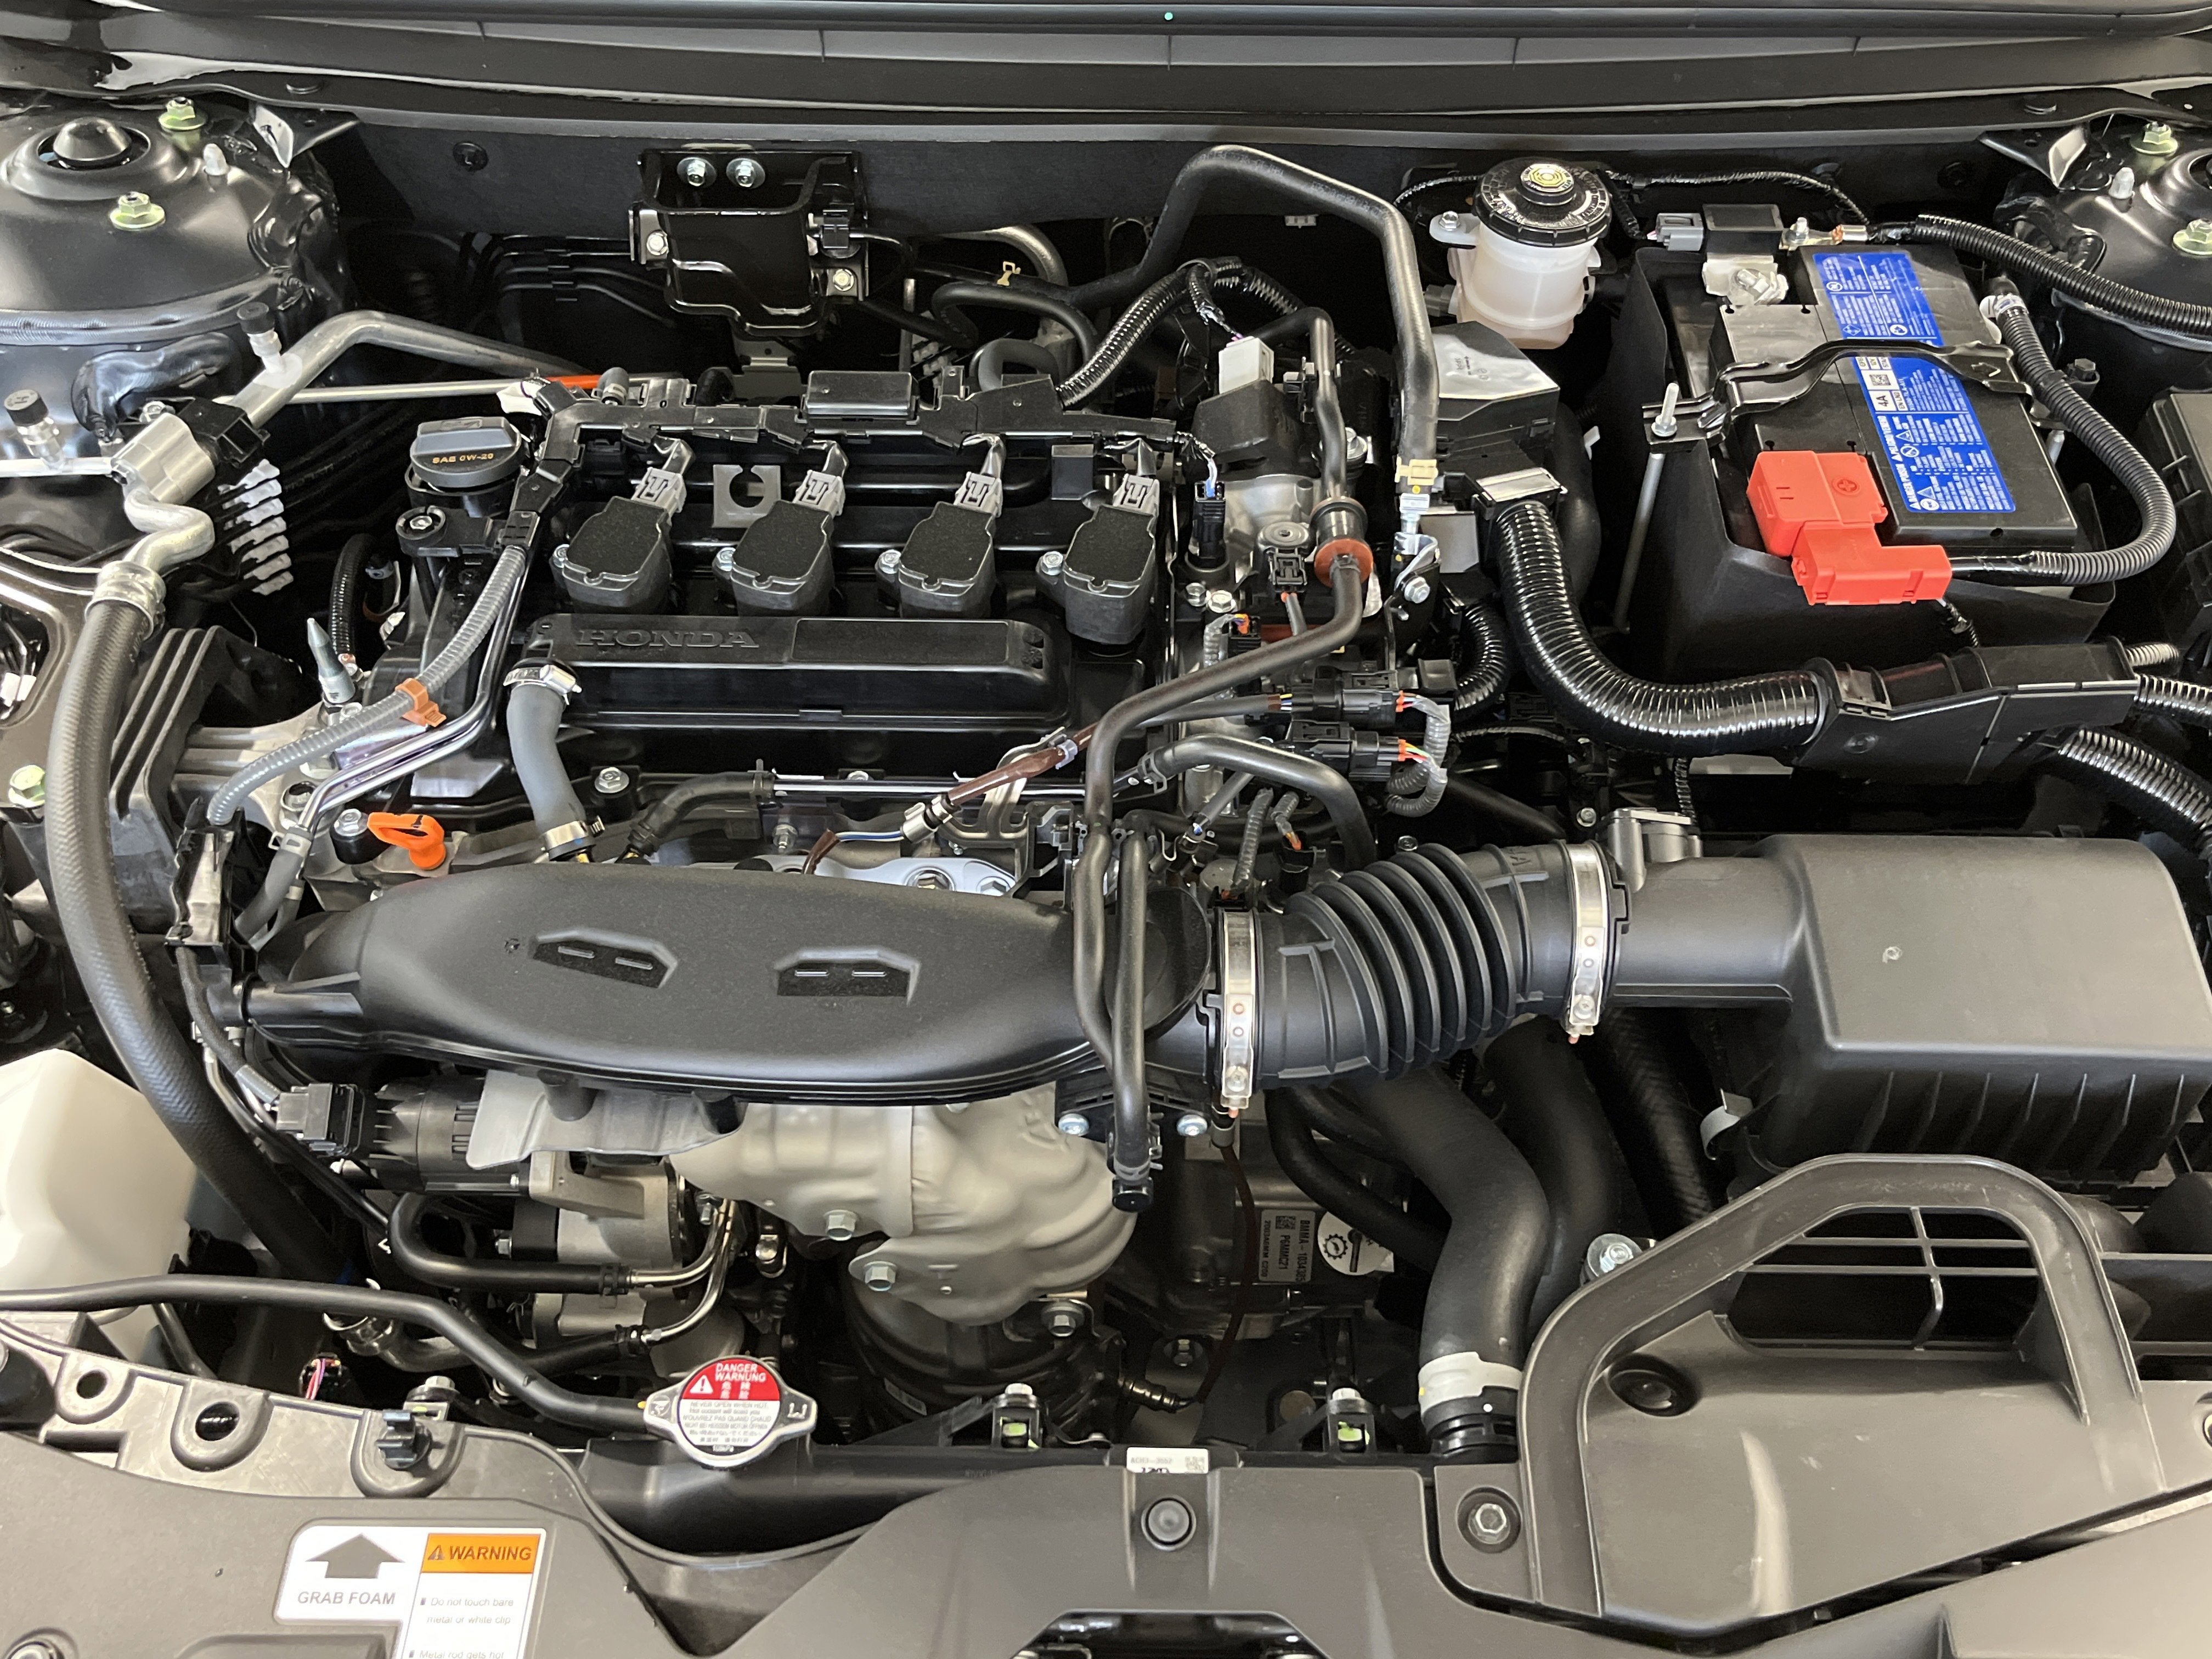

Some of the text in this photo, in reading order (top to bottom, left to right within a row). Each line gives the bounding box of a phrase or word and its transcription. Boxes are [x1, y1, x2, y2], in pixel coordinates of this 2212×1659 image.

[1876, 395, 1888, 407] 4A
[459, 453, 494, 461] 0W-20
[576, 630, 759, 648] HONDA
[715, 1363, 758, 1372] DANGER
[715, 1372, 766, 1382] WARNUNG
[450, 1546, 532, 1560] WARNING
[297, 1591, 396, 1605] GRAB FOAM
[431, 1598, 444, 1606] Do
[465, 1598, 489, 1606] touch
[493, 1598, 514, 1606] bare
[495, 1616, 511, 1626] clip
[420, 1650, 445, 1659] Metal
